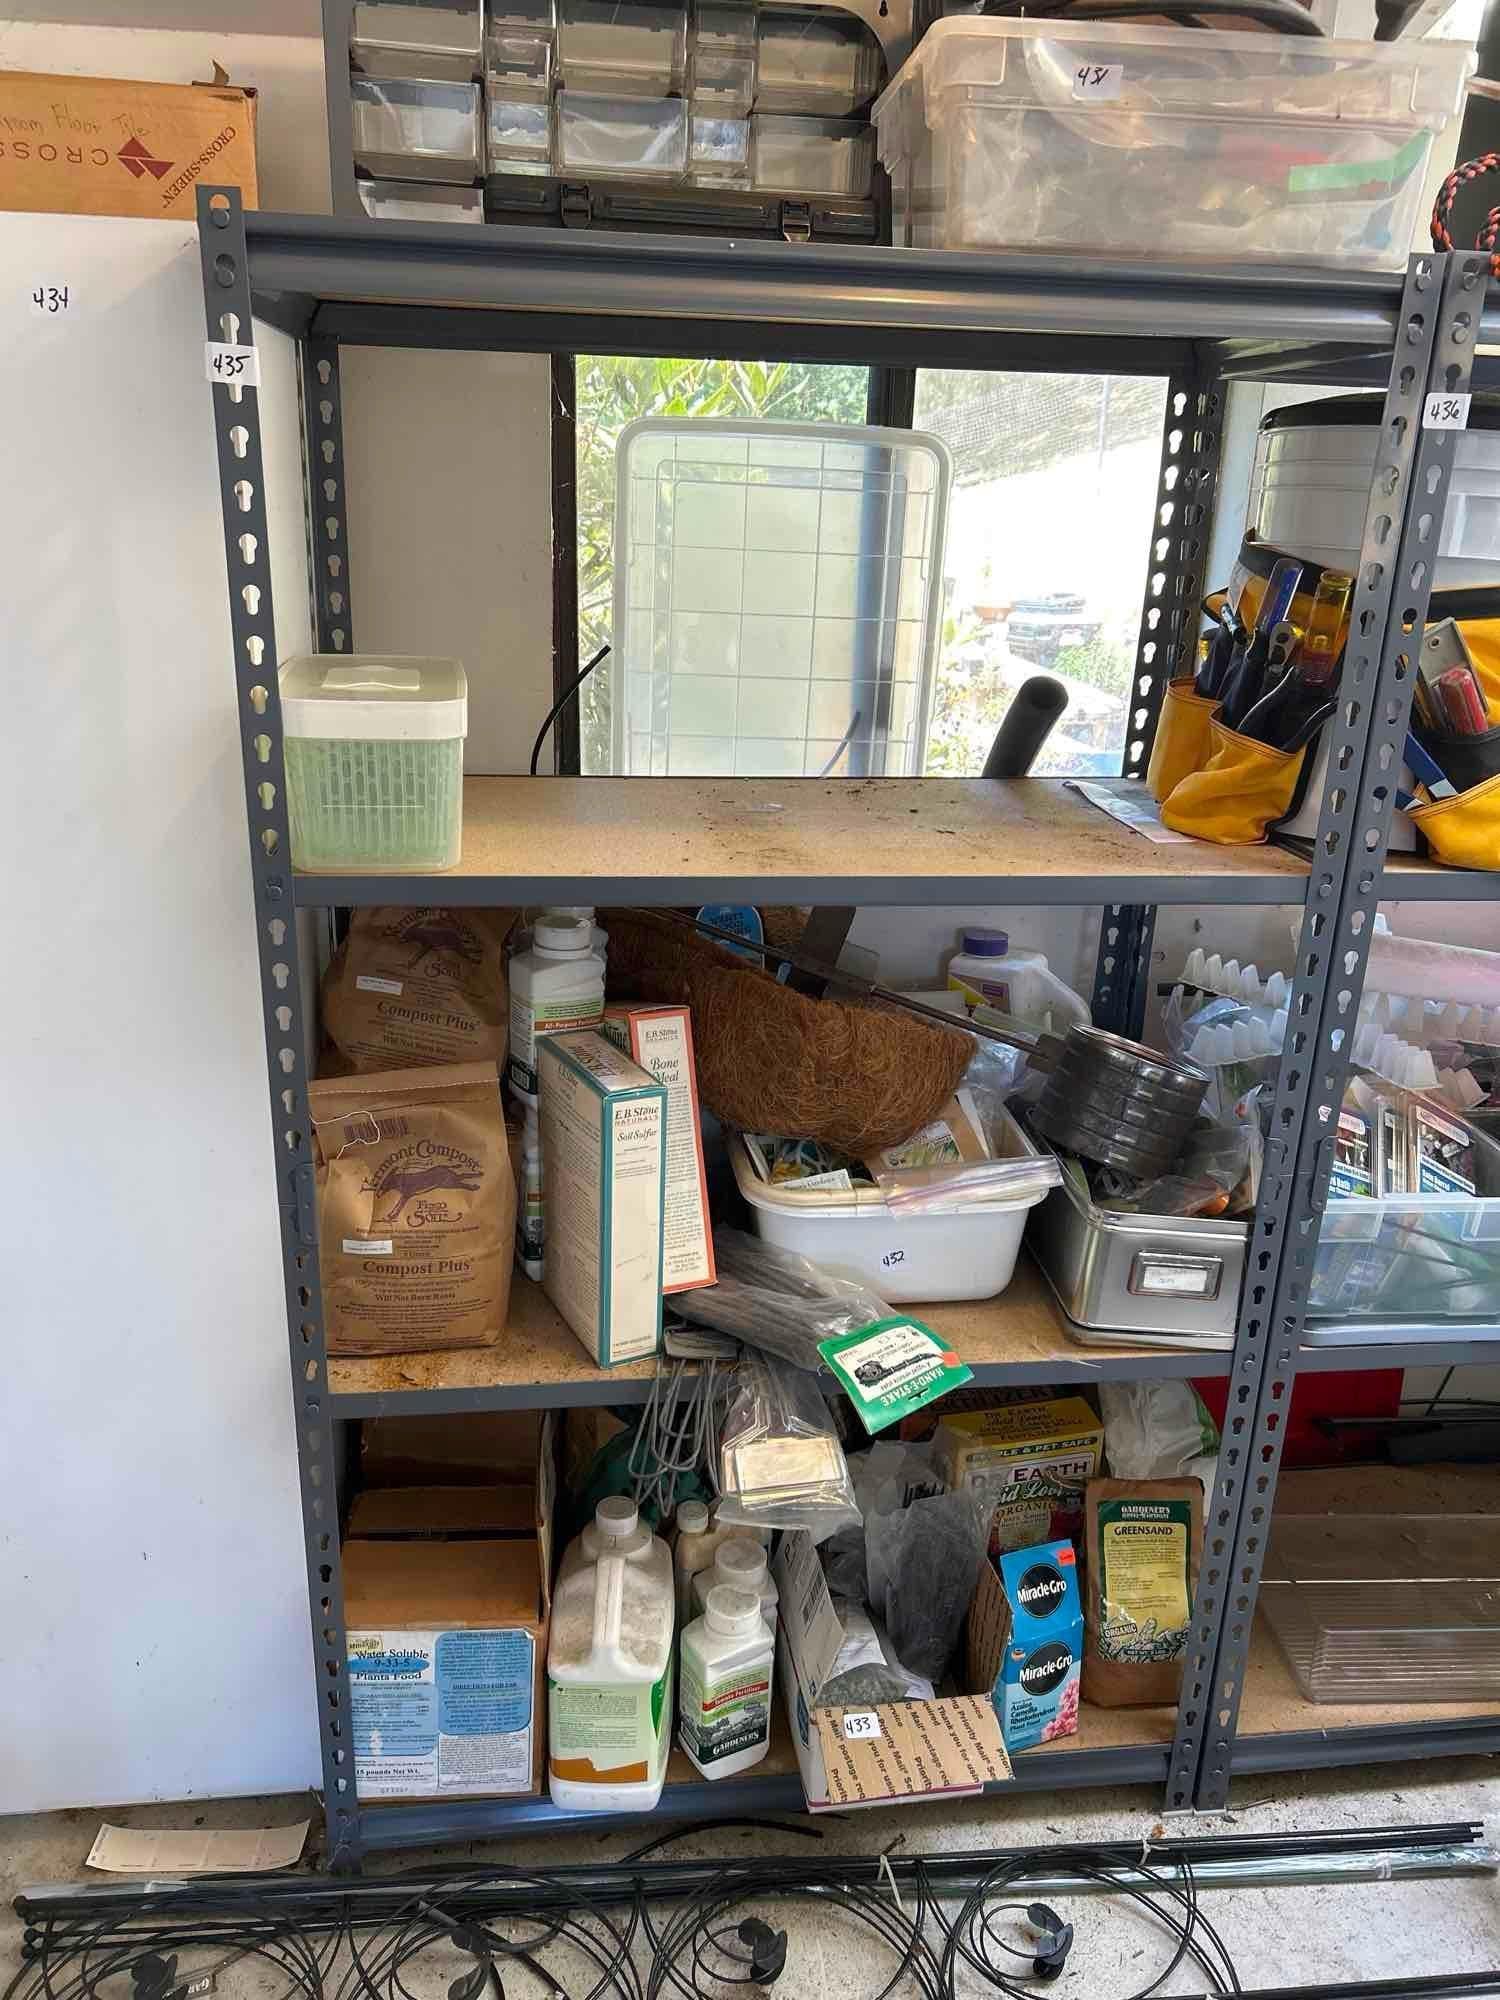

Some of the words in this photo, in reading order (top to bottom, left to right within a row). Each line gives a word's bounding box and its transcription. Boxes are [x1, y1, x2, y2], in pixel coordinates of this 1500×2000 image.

[1078, 67, 1110, 87] 431
[0, 142, 109, 166] CROS
[32, 287, 69, 312] 434
[213, 353, 251, 376] 435
[1429, 401, 1461, 422] 436
[377, 1001, 443, 1025] Compost
[650, 1057, 680, 1072] Bone
[362, 1260, 433, 1278] Compost
[882, 1250, 905, 1267] 432
[1114, 1526, 1174, 1536] GREENSAND
[1104, 1623, 1137, 1638] ORGANIC
[355, 1650, 387, 1660] Water
[389, 1648, 430, 1659] Soluble
[374, 1659, 410, 1668] 9-33-5
[394, 1672, 422, 1681] Food
[922, 1701, 941, 1727] quired
[967, 1695, 984, 1720] ervice
[846, 1717, 871, 1735] 433
[957, 1710, 978, 1741] Priority
[887, 1702, 903, 1727] ervice
[914, 1755, 933, 1791] Priorit
[921, 1733, 942, 1769] postage
[937, 1704, 954, 1731] Thank
[949, 1731, 962, 1748] you
[960, 1748, 970, 1762] for
[967, 1763, 981, 1784] usin
[838, 1743, 858, 1781] postage
[867, 1740, 881, 1758] you
[876, 1759, 887, 1774] for
[883, 1774, 896, 1798] usin
[831, 1767, 849, 1801] Priorit
